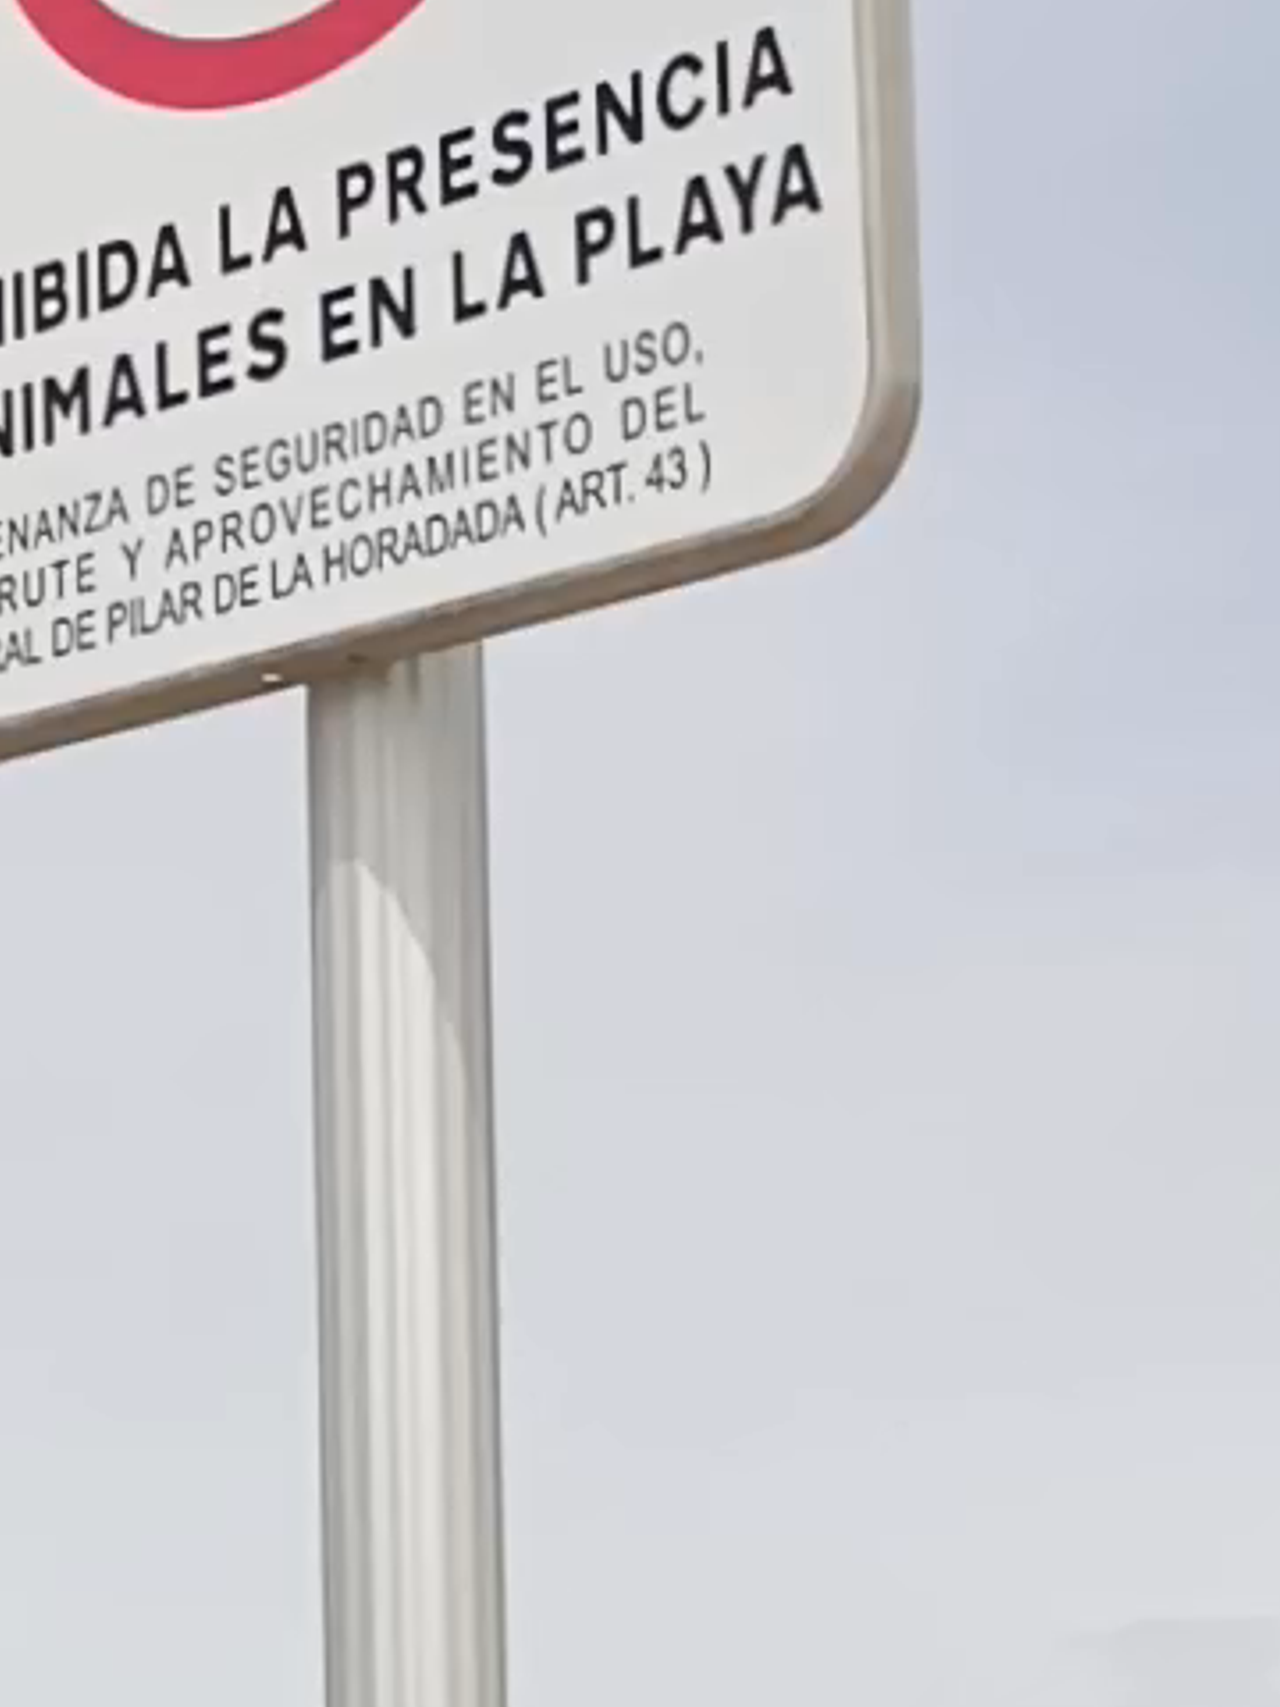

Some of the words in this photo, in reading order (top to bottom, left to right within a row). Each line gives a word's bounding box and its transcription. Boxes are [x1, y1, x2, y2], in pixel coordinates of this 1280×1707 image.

[219, 185, 307, 274] LA
[337, 26, 793, 240] PRESENCIA
[320, 266, 417, 364] EN
[453, 230, 545, 323] LA
[574, 143, 822, 286] PLAYA
[120, 538, 144, 581] Y
[165, 412, 593, 571] APROVECHAMIENTO
[621, 383, 706, 441] DEL
[147, 464, 195, 516] DE
[213, 396, 444, 497] SEGURIDAD
[463, 372, 516, 425] EN
[536, 356, 583, 403] EL
[604, 321, 704, 383] USO,
[52, 610, 96, 658] DE
[107, 581, 203, 645] PILAR
[215, 564, 261, 615] DE
[271, 552, 314, 599] LA
[322, 494, 526, 586] HORADADA
[535, 462, 636, 538] (ART.
